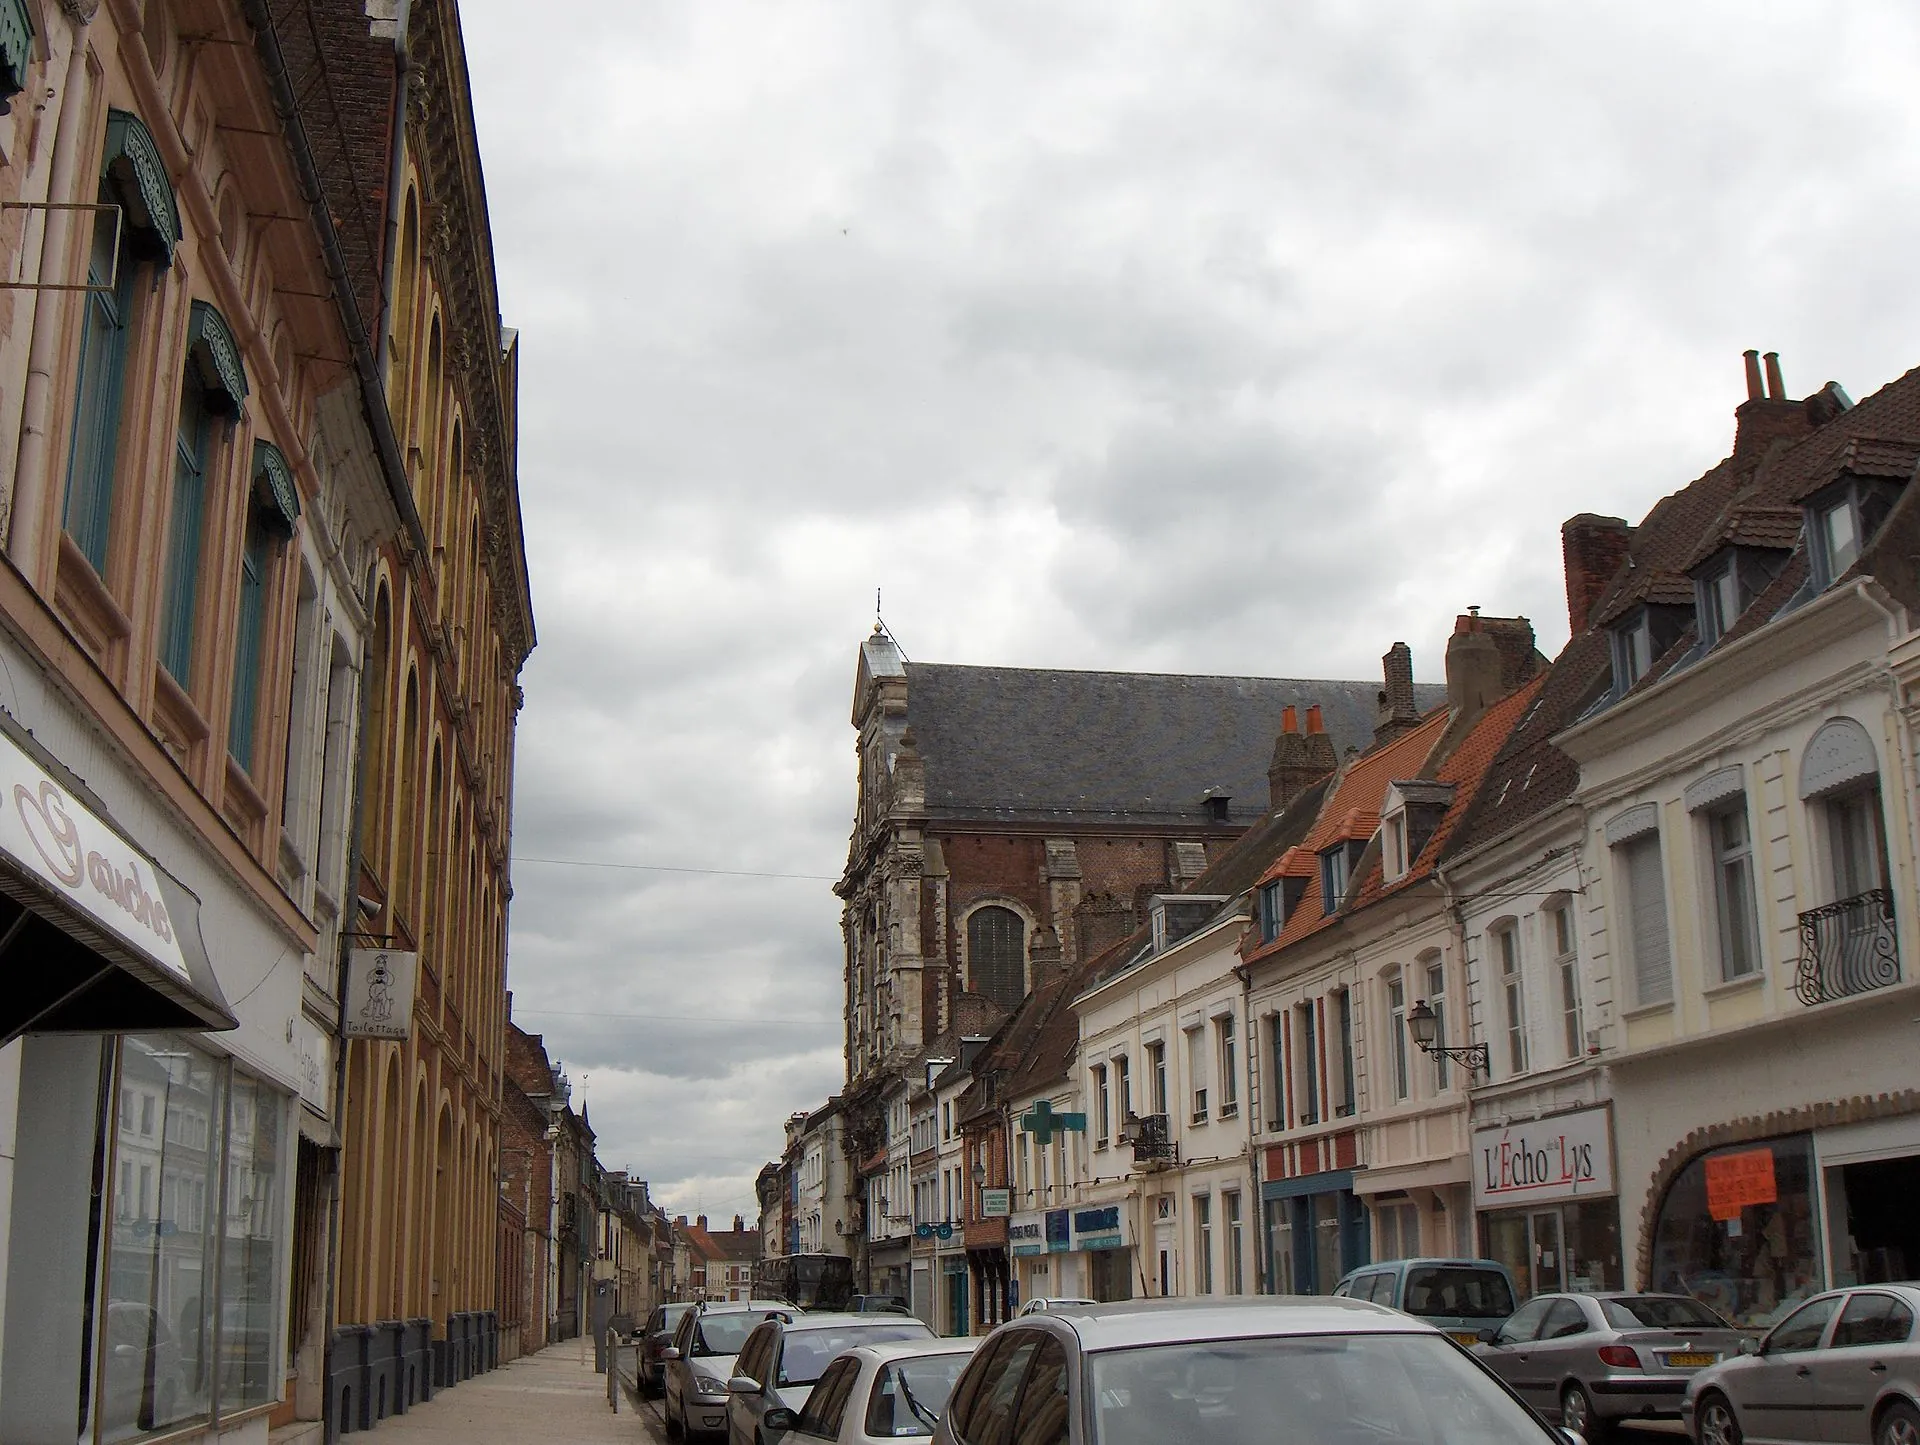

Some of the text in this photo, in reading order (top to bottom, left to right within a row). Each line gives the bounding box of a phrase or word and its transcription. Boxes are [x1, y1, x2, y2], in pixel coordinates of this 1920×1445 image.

[13, 780, 172, 944] Gauche
[1484, 1129, 1548, 1190] L'Écho
[1559, 1135, 1592, 1194] Lys
